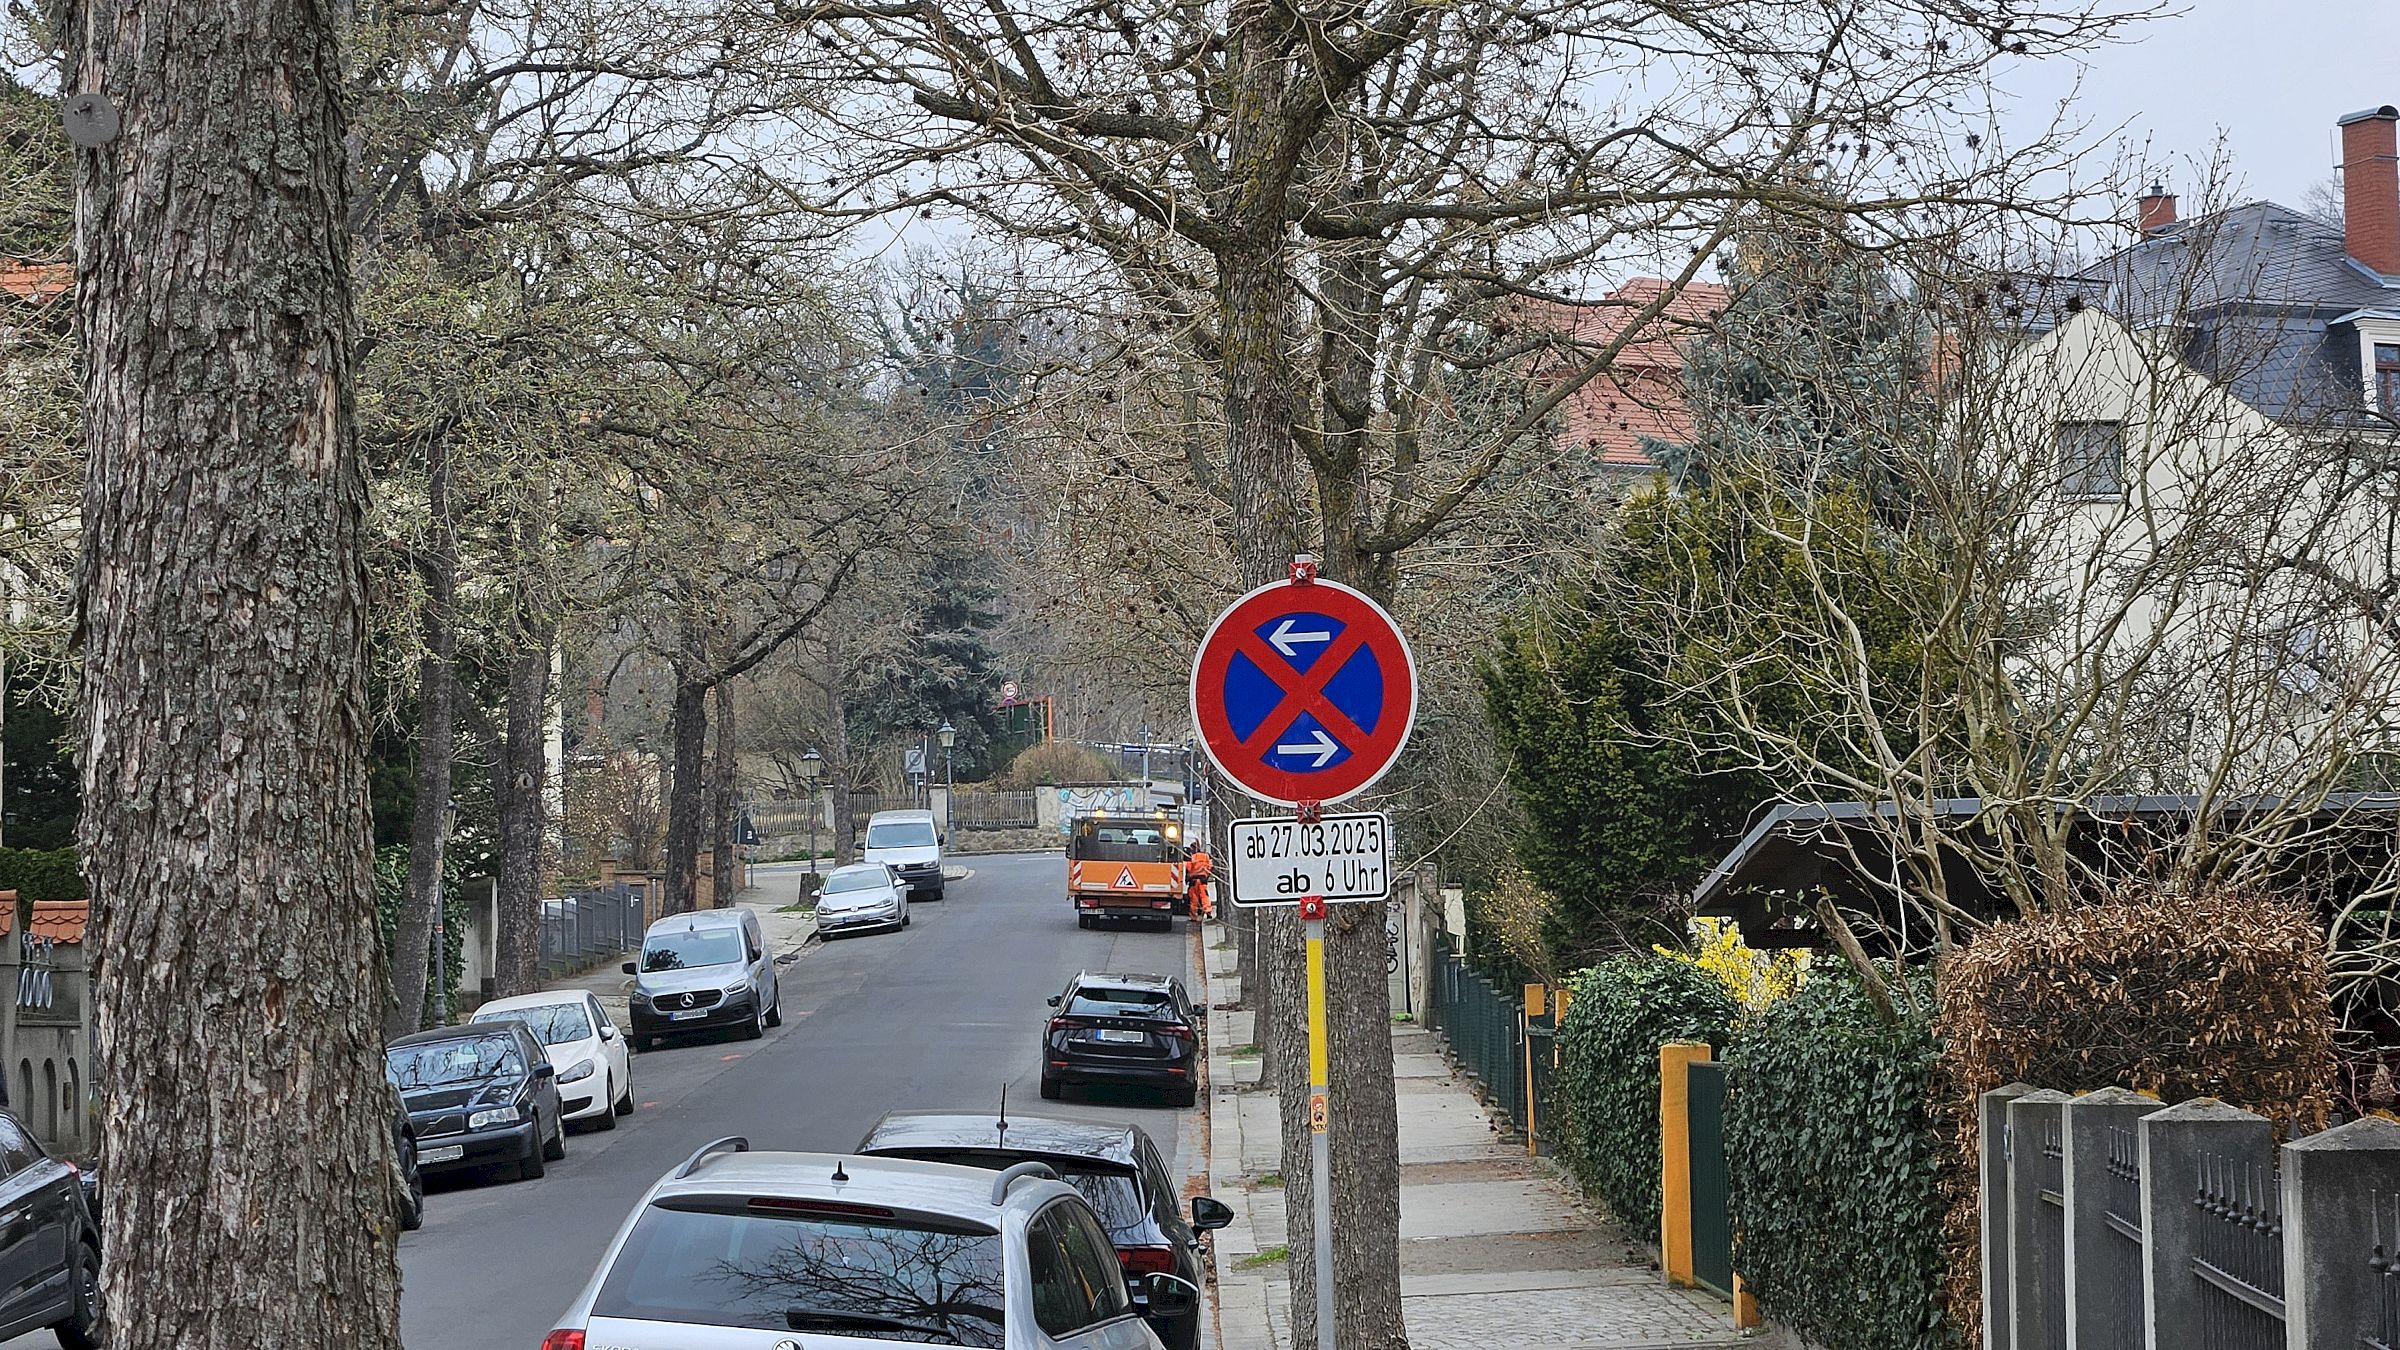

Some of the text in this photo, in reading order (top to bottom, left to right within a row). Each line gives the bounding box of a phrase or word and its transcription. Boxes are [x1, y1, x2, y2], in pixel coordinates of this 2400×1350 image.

[1246, 821, 1379, 859] ab 27.03.2025
[1276, 858, 1379, 894] ab 6 Uhr
